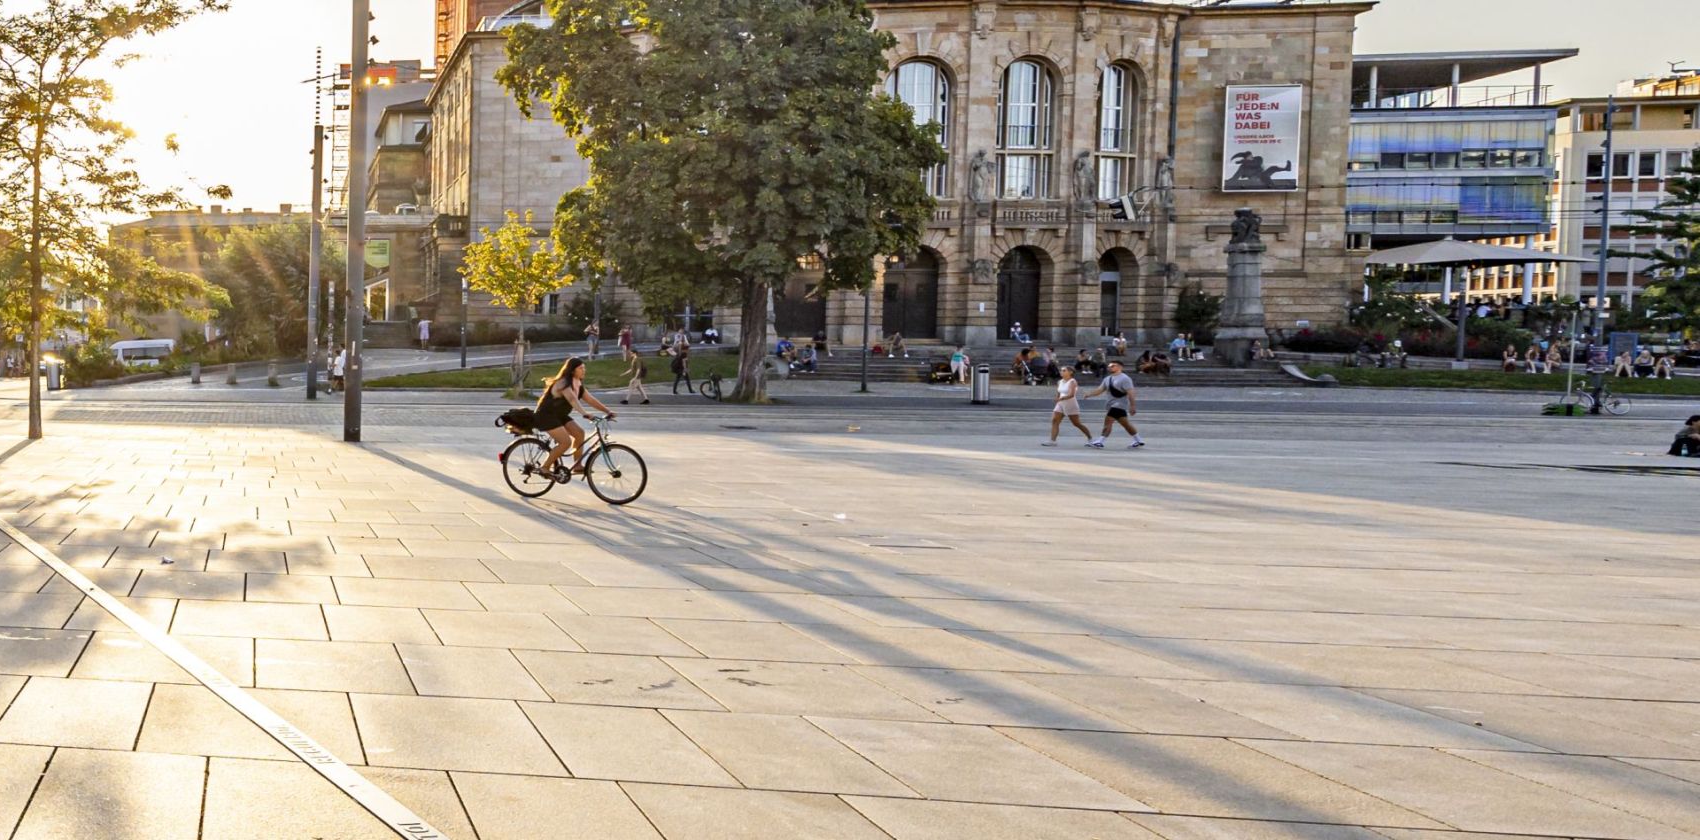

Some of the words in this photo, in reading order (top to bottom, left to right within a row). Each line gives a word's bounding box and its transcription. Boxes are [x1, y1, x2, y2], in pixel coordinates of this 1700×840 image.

[1236, 92, 1260, 102] FÜR
[1235, 102, 1279, 111] JEDE:N
[1235, 112, 1262, 120] WAS
[1235, 121, 1270, 130] DABEI
